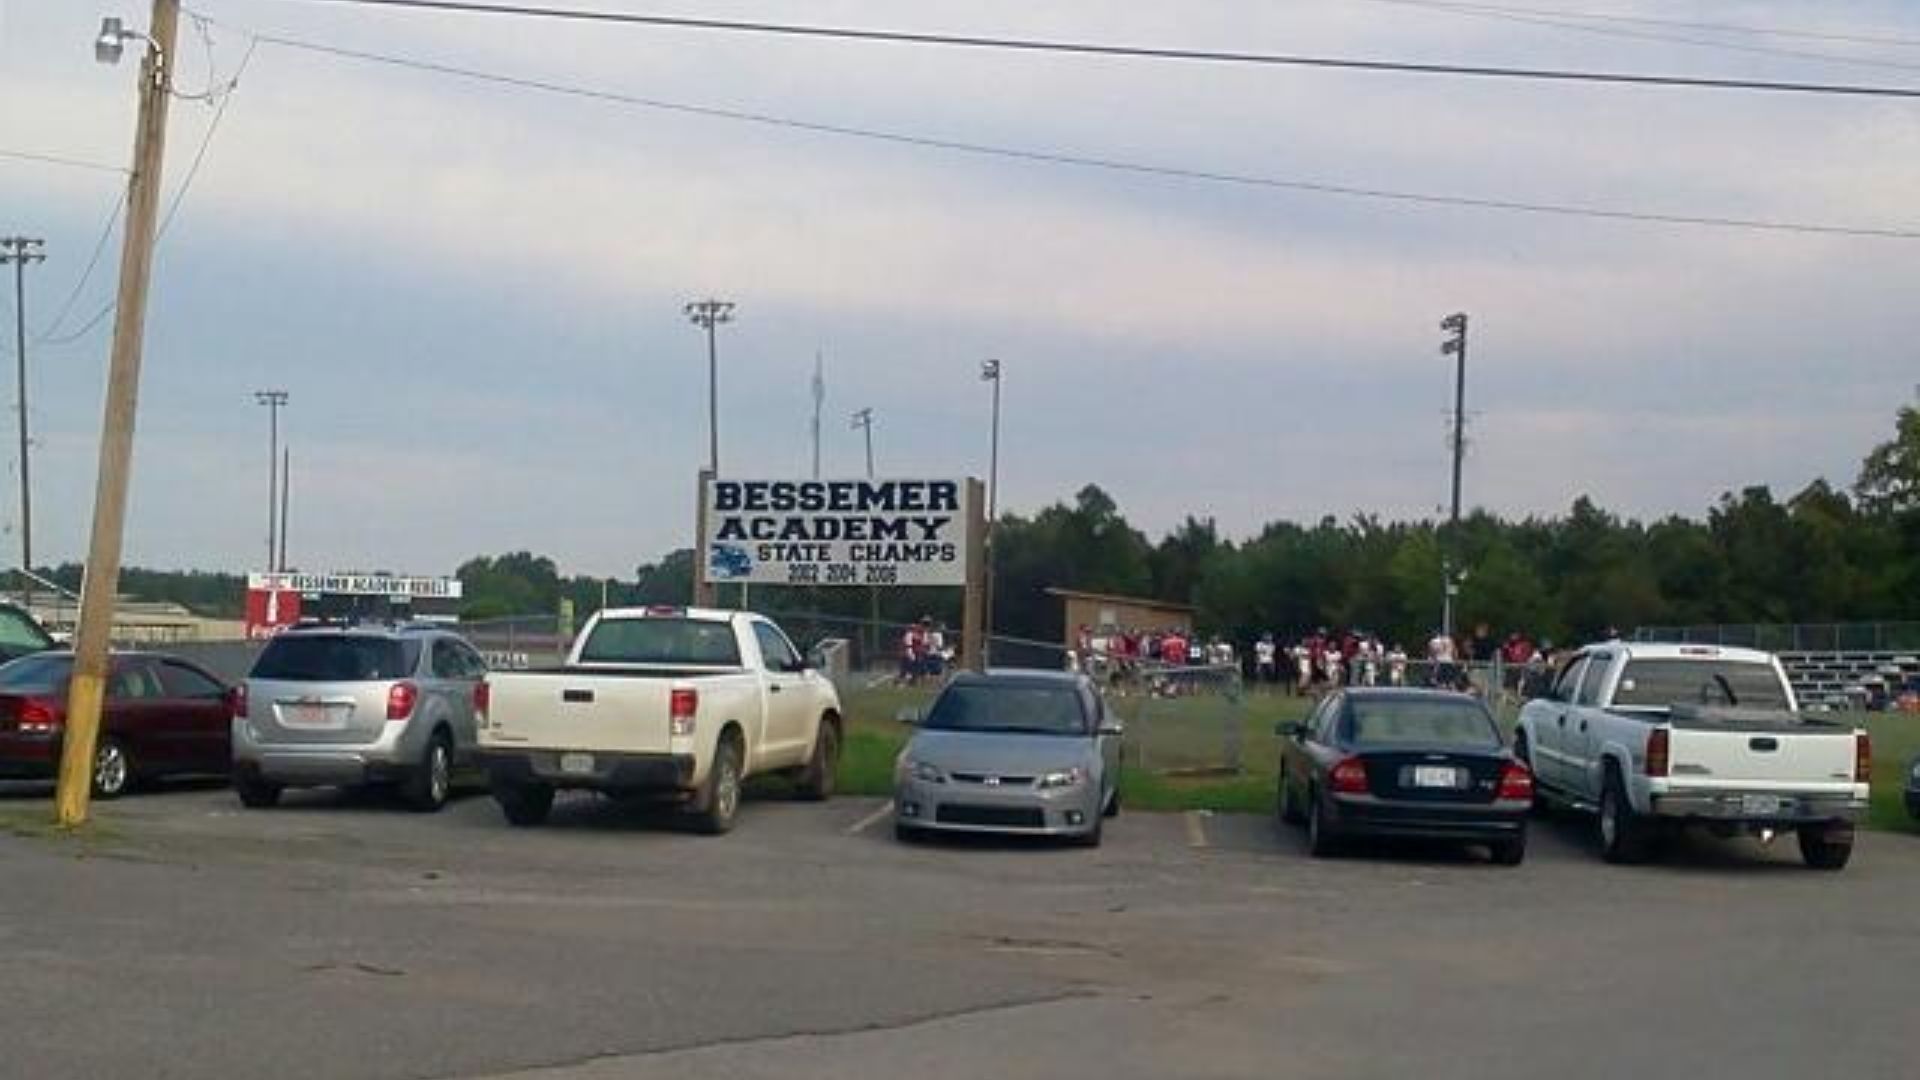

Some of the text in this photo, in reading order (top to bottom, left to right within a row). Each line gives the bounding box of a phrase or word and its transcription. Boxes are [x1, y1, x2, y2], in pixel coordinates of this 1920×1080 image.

[715, 482, 958, 511] BESSEMER
[716, 517, 951, 541] ACADEMY
[757, 543, 956, 562] STATE CHAMPS
[353, 576, 407, 593] ACADEMY
